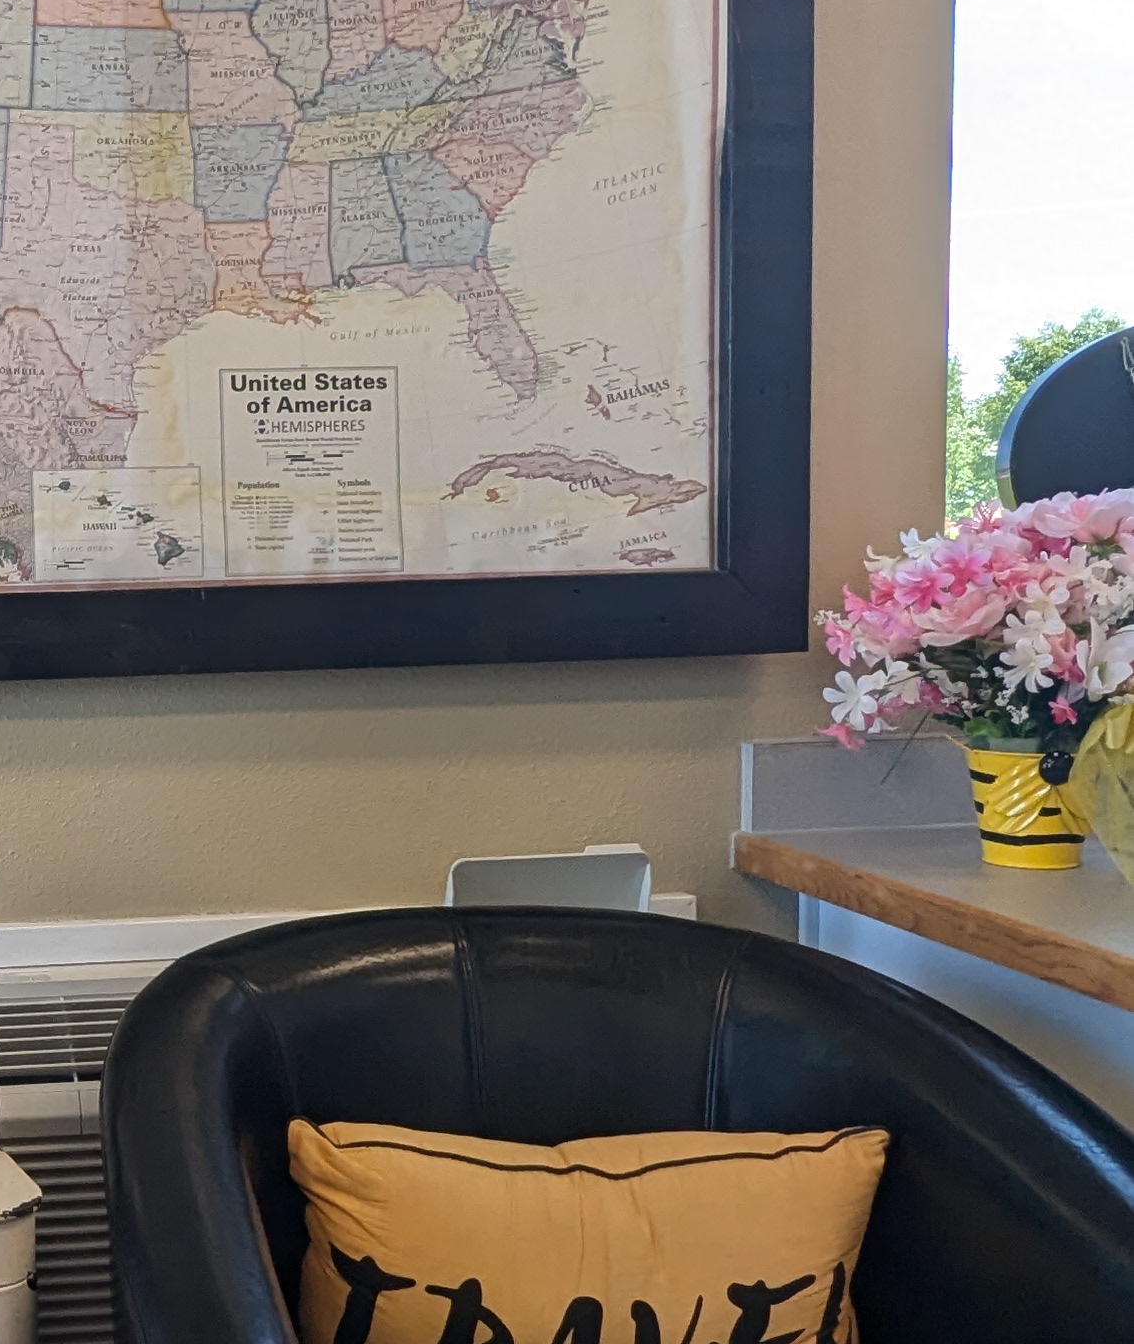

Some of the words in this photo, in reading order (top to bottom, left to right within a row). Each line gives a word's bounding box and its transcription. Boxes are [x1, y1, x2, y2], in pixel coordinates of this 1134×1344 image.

[333, 17, 377, 26] INDIANA
[461, 167, 515, 182] CAROLINA
[592, 163, 666, 192] ATLANTIC
[607, 184, 658, 207] OCEAN
[271, 206, 326, 216] MISSISSIPPI
[341, 211, 387, 223] ALABAMA
[70, 245, 101, 253] TEXAS
[366, 329, 378, 339] of
[231, 374, 306, 392] United
[315, 373, 387, 390] States
[606, 379, 670, 404] BAHAMAS
[247, 397, 270, 414] of
[276, 396, 372, 413] America
[271, 419, 366, 434] HEMISPHERES
[238, 481, 279, 490] Population
[337, 479, 371, 488] Symbols
[568, 475, 612, 492] CUBA
[83, 523, 117, 531] HAWAII
[620, 531, 667, 549] JAMAICA
